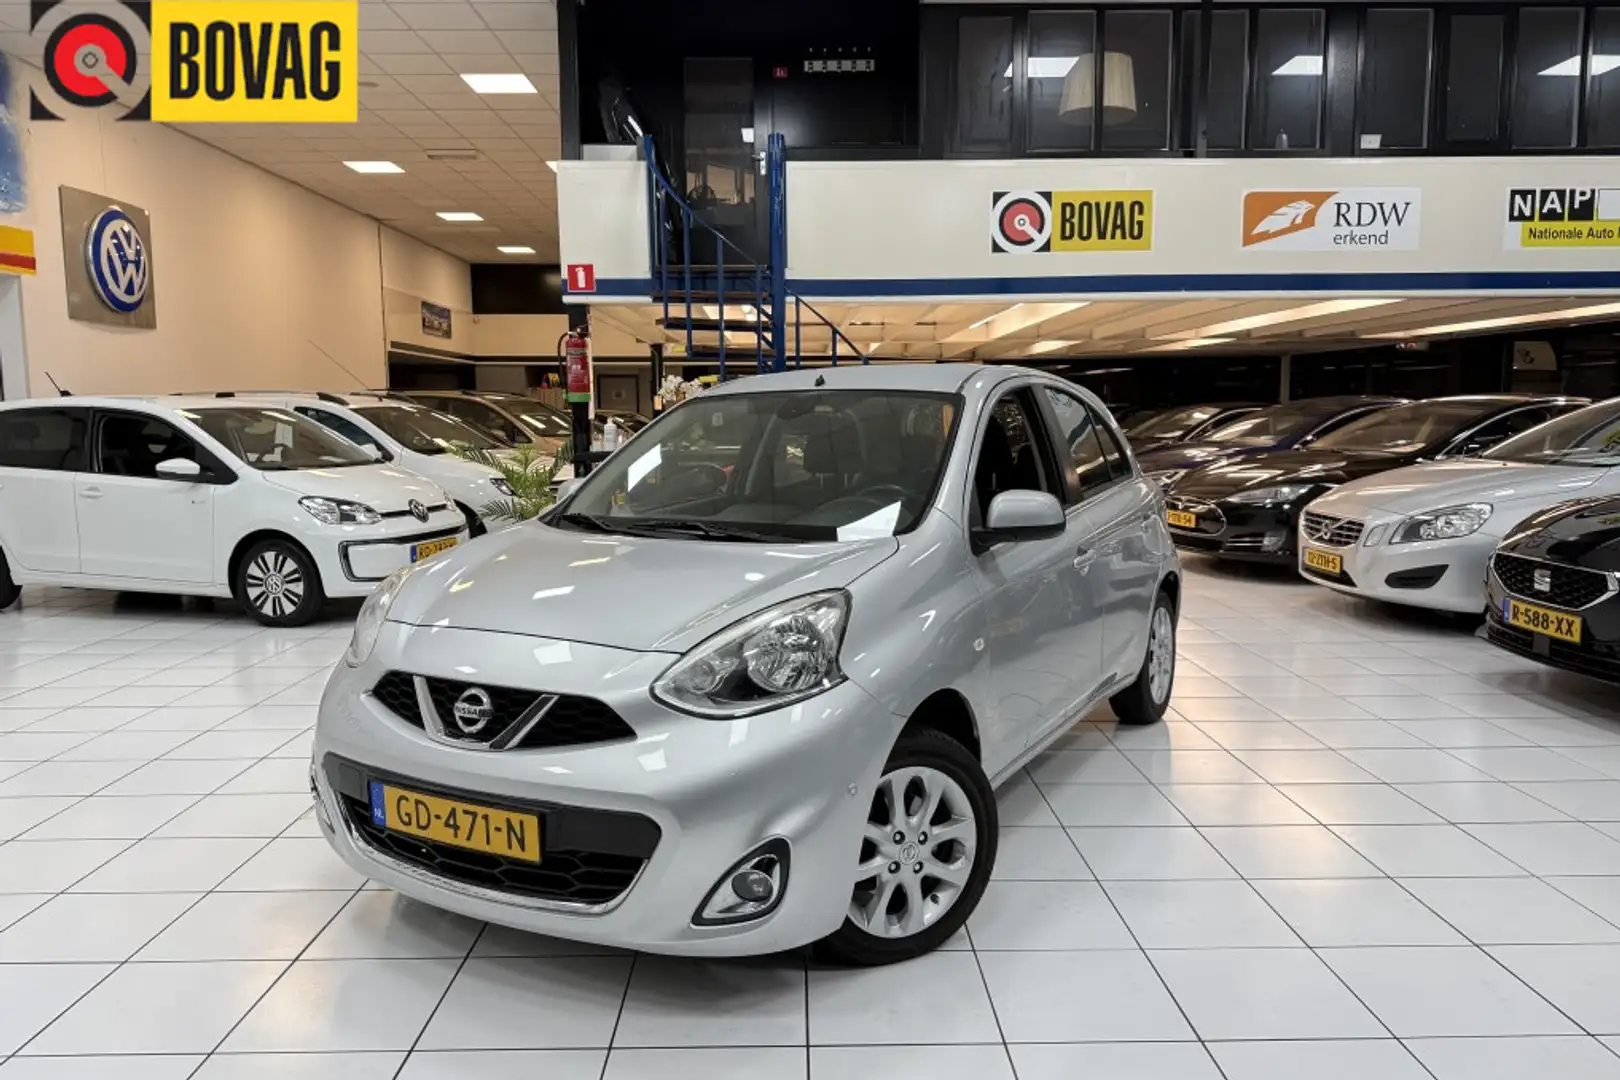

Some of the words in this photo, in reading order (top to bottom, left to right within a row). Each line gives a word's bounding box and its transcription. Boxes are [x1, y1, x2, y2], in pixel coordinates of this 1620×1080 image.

[1333, 202, 1411, 227] RDW
[1512, 189, 1593, 217] NAP
[1060, 200, 1145, 241] BOVAG
[1528, 226, 1584, 240] Nationale
[1586, 226, 1615, 240] Auto
[1333, 229, 1389, 246] erkend
[1512, 603, 1575, 637] R-588-XX
[396, 795, 525, 852] GD-471-N
